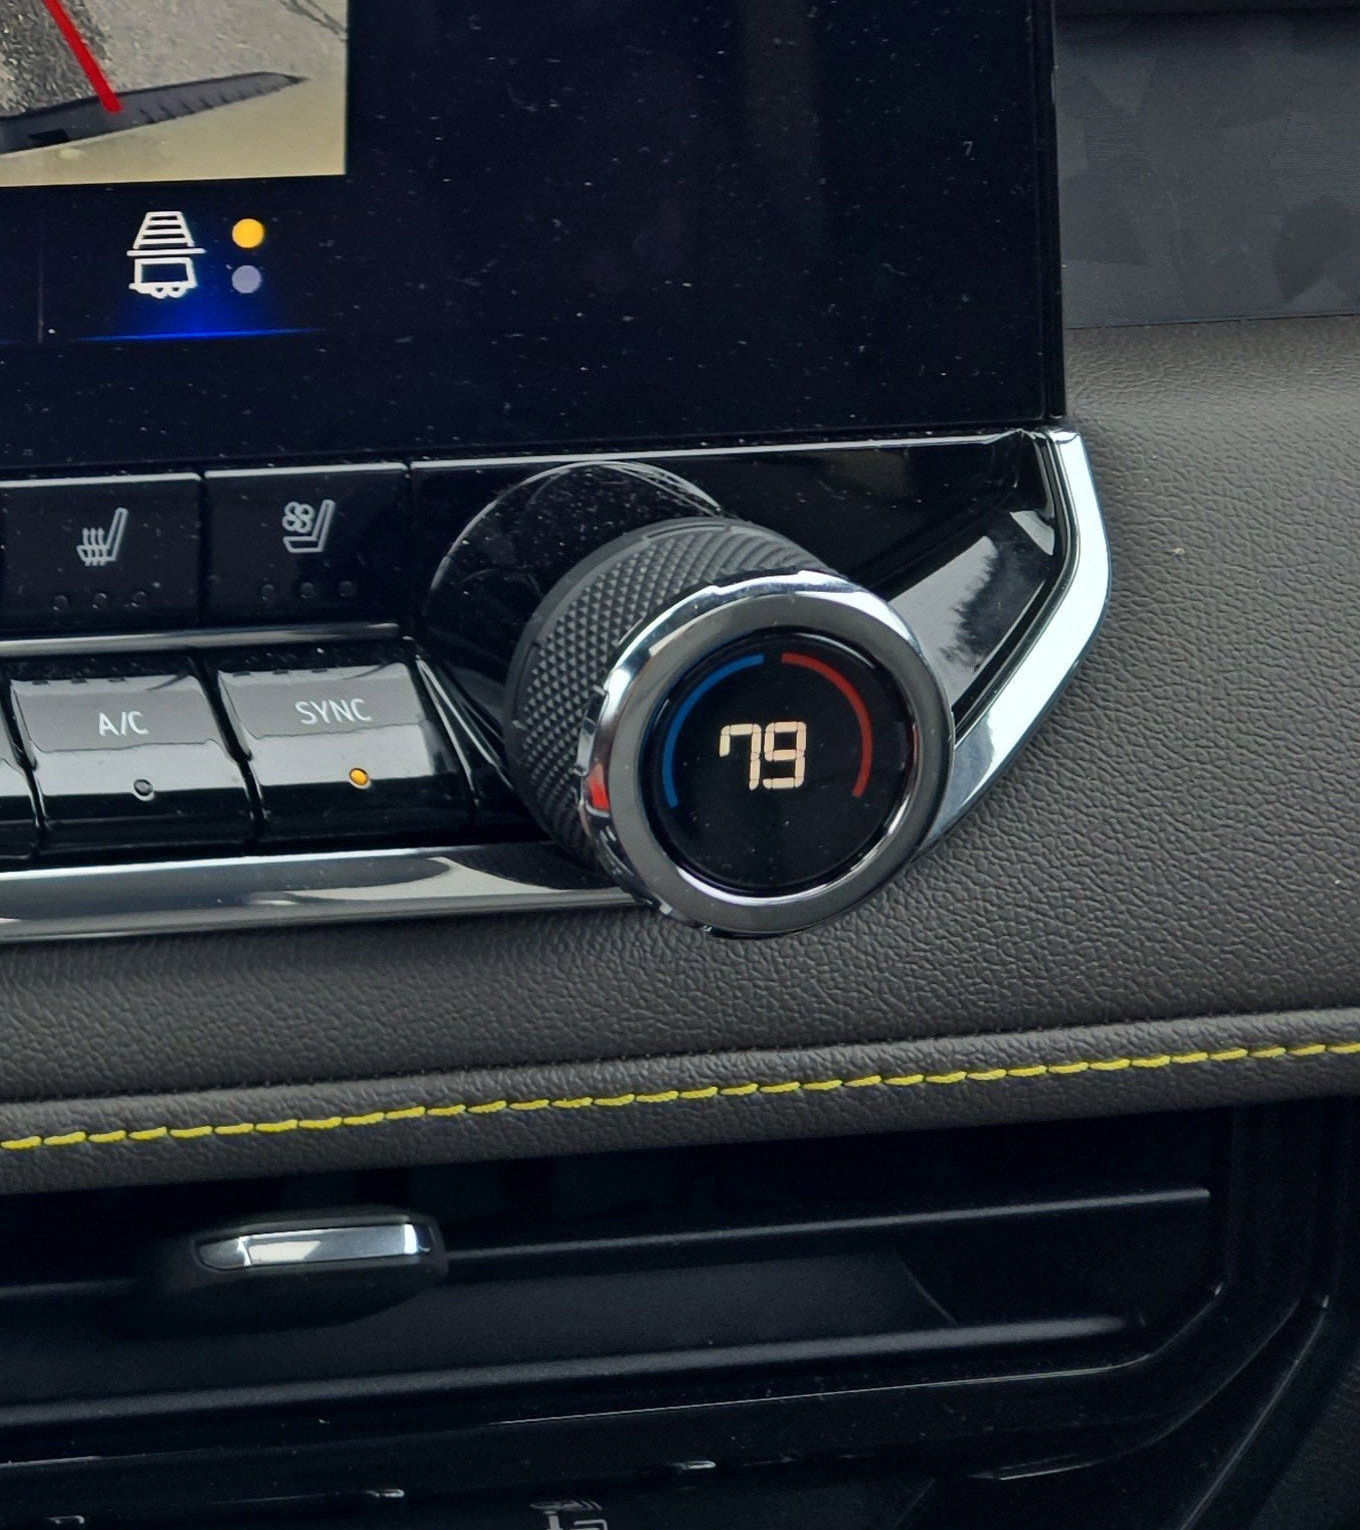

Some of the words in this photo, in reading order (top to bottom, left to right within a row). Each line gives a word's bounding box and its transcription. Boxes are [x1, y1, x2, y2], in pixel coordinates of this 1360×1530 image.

[97, 710, 149, 738] A/C
[294, 697, 374, 727] SYNC
[718, 720, 808, 791] 79
